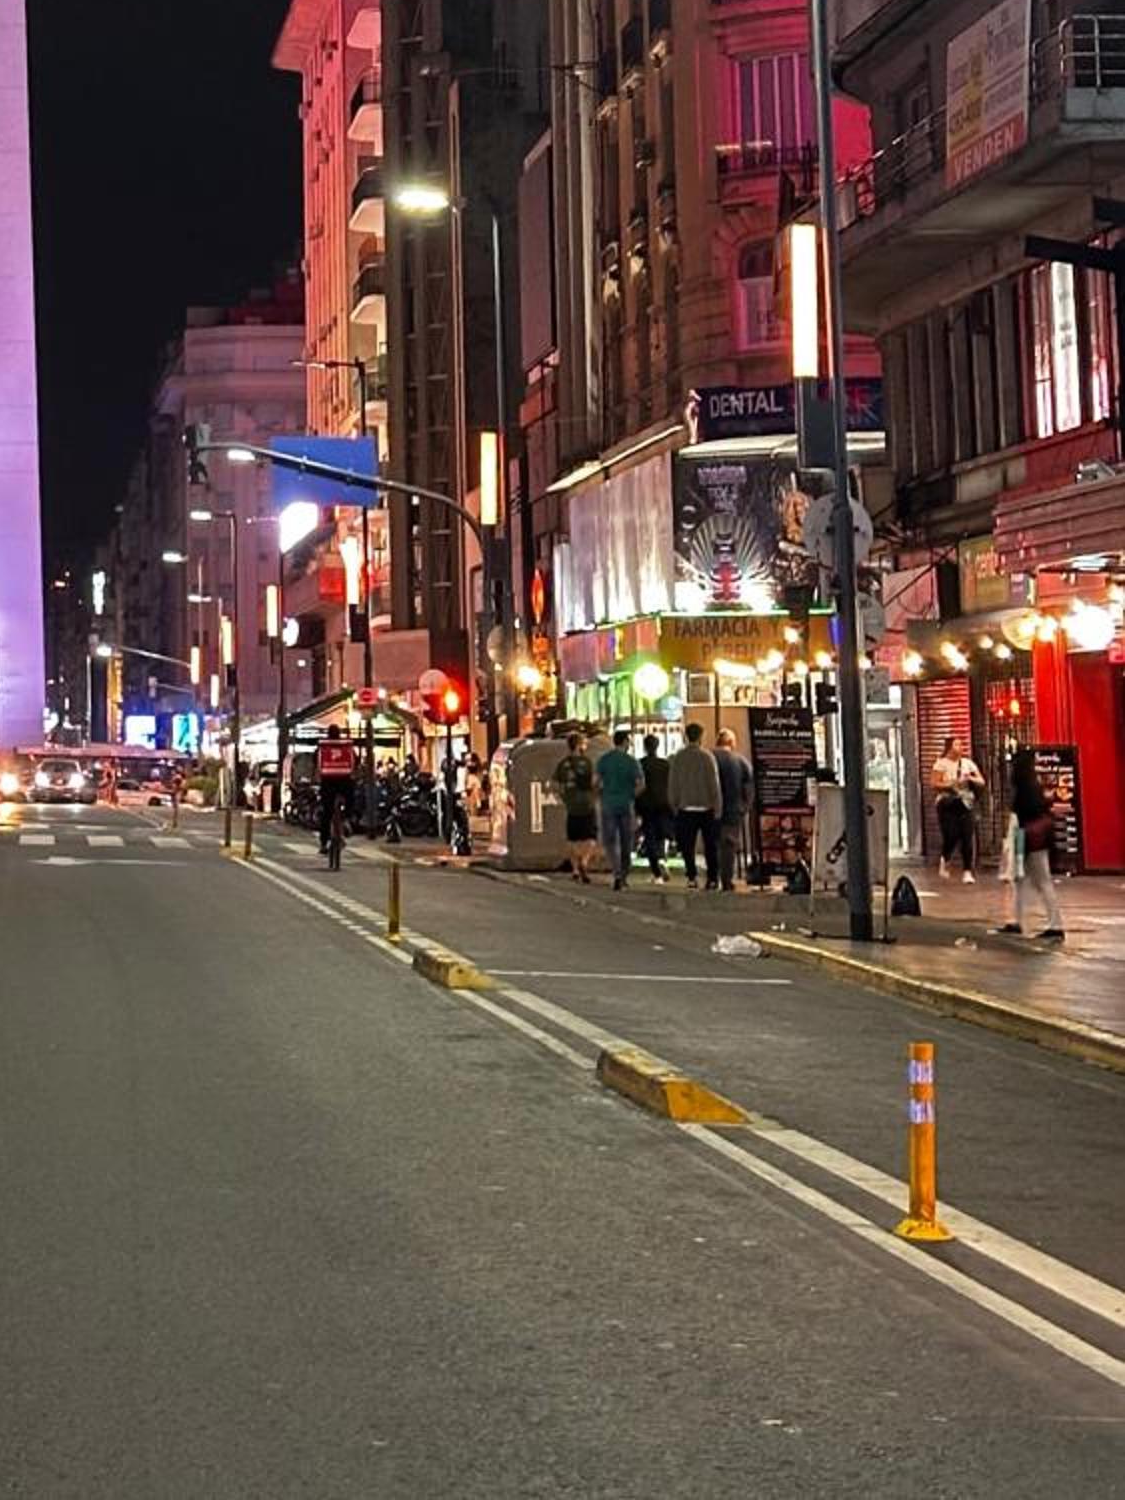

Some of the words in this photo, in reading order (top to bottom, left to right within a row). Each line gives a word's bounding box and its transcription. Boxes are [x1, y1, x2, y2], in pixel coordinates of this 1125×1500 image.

[953, 121, 1015, 182] VENDEN
[710, 390, 784, 419] DENTAL
[675, 618, 761, 638] FARMACIA
